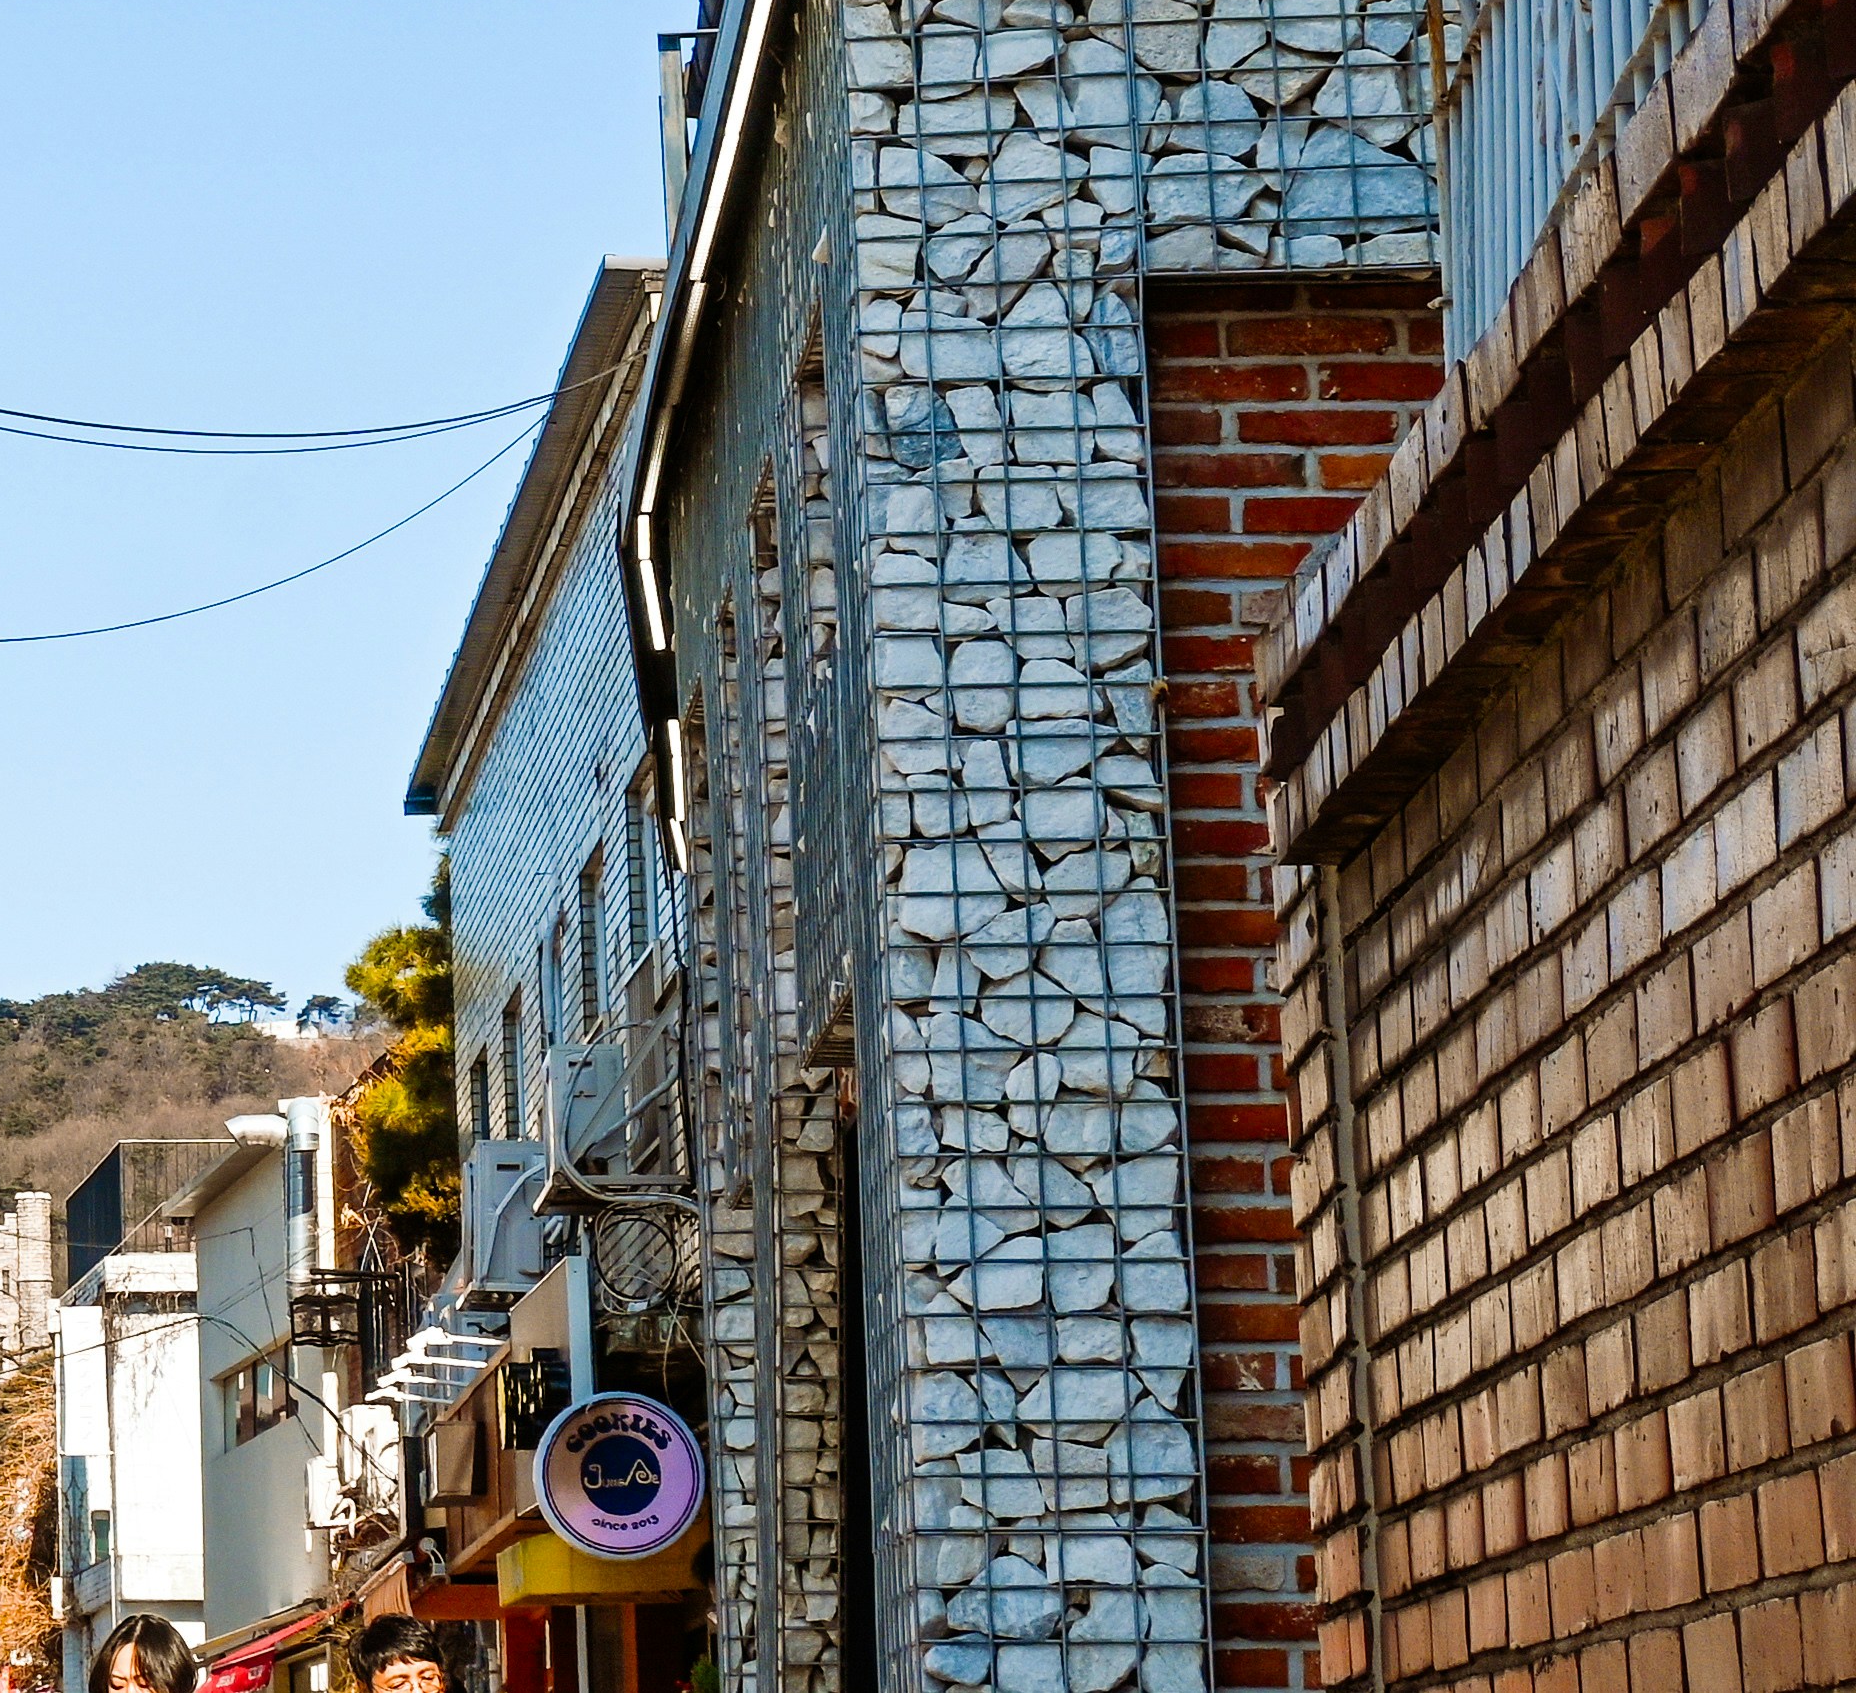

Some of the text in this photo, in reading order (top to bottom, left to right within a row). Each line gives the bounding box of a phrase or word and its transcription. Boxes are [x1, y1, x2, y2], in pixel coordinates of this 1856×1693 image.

[565, 1412, 672, 1454] COOKIES
[591, 1514, 660, 1531] since 2013
